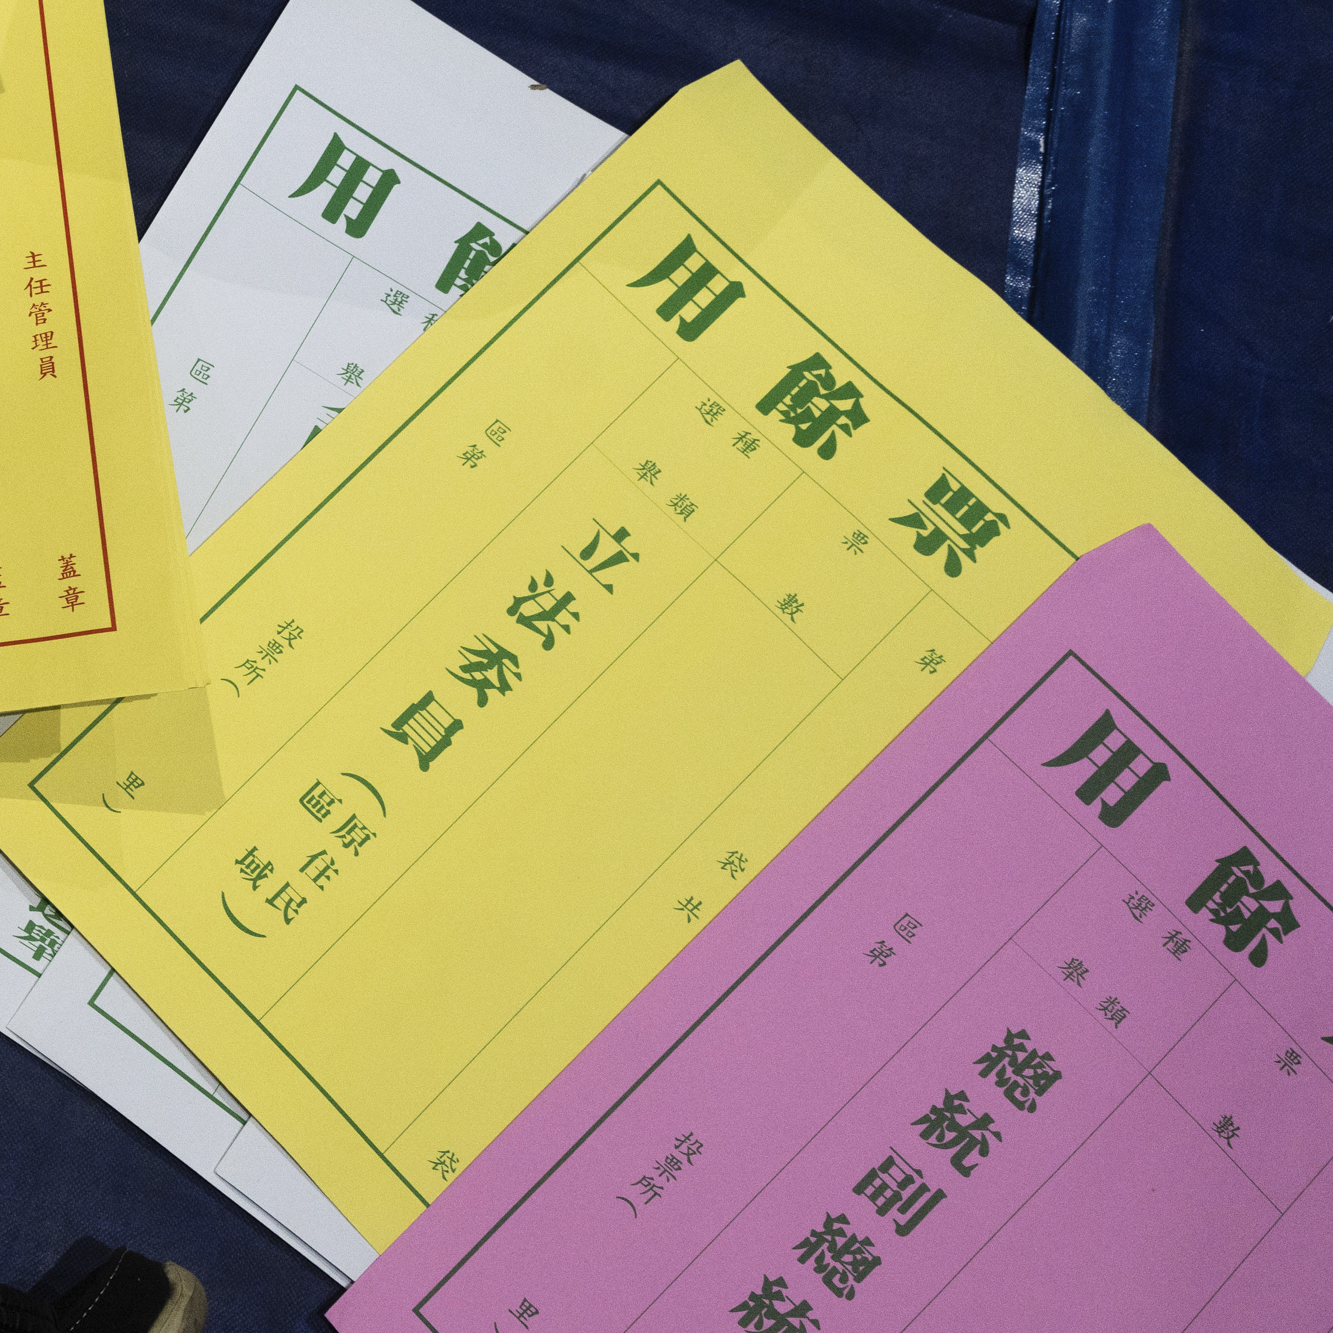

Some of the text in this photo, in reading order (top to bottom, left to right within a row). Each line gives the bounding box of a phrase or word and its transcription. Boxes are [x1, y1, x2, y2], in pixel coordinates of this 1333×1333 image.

[24, 251, 58, 380] 主任管理員
[338, 287, 410, 400] 選舉
[168, 358, 215, 414] 區第
[626, 233, 1010, 577] 用餘票
[459, 418, 511, 469] 區第
[635, 397, 726, 487] 選舉
[668, 430, 761, 523] 種類
[58, 553, 85, 612] 蓋章
[777, 529, 869, 624] 票數
[381, 521, 640, 773] 立法委員
[915, 646, 947, 677] 第
[265, 813, 377, 926] 原住民
[1041, 708, 1333, 1048] 用餘
[865, 912, 923, 968] 區第
[1058, 890, 1156, 988] 選舉
[1097, 929, 1192, 1029] 種類
[1212, 1047, 1302, 1149] 票數
[429, 1148, 460, 1181] 袋
[729, 1028, 1063, 1333] 總統副總統
